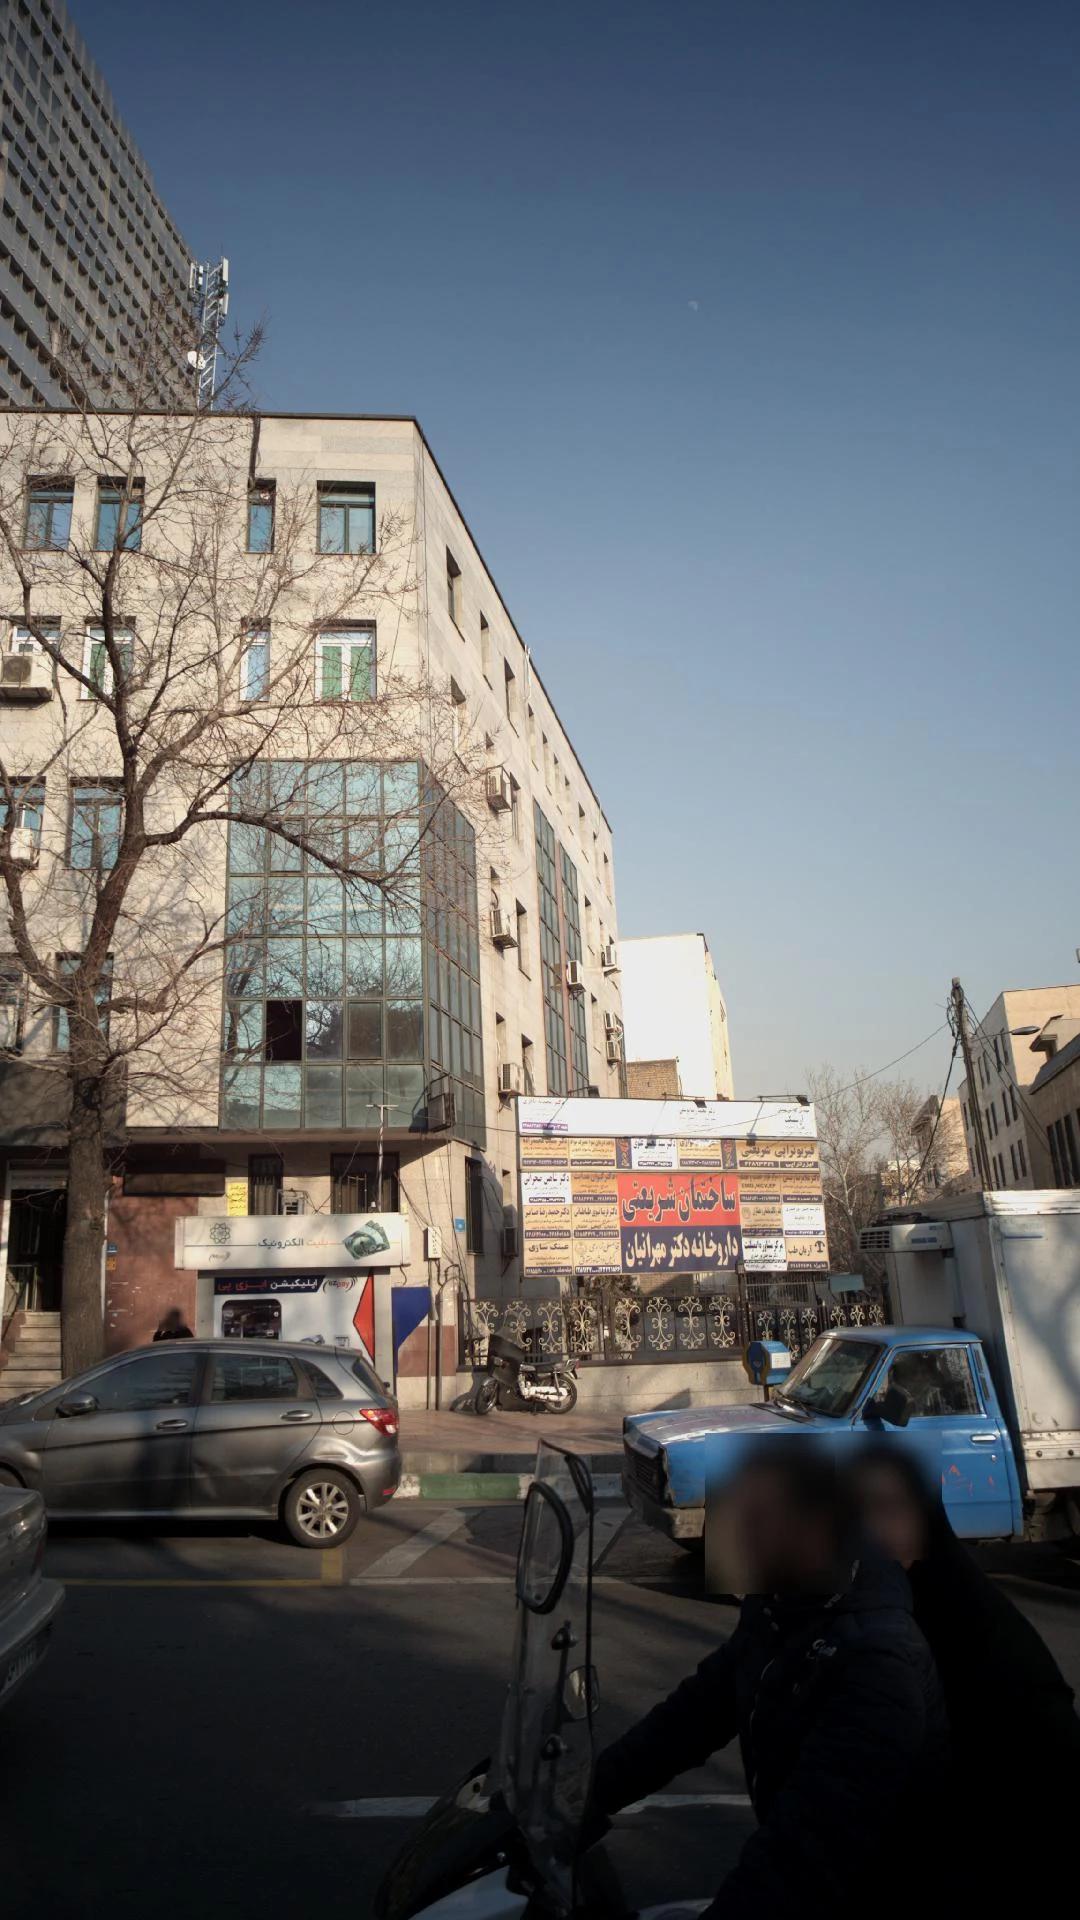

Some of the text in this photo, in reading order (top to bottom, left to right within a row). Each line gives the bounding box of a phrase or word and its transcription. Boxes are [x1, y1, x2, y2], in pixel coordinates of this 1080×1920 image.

[622, 1175, 737, 1223] ساختمان شریعتی
[257, 1238, 304, 1250] الکترونیک
[528, 1242, 569, 1253] عینک سازی
[625, 1231, 739, 1268] داروخانه دکتر مهرانیان
[270, 1279, 318, 1290] اپلیکیشن
